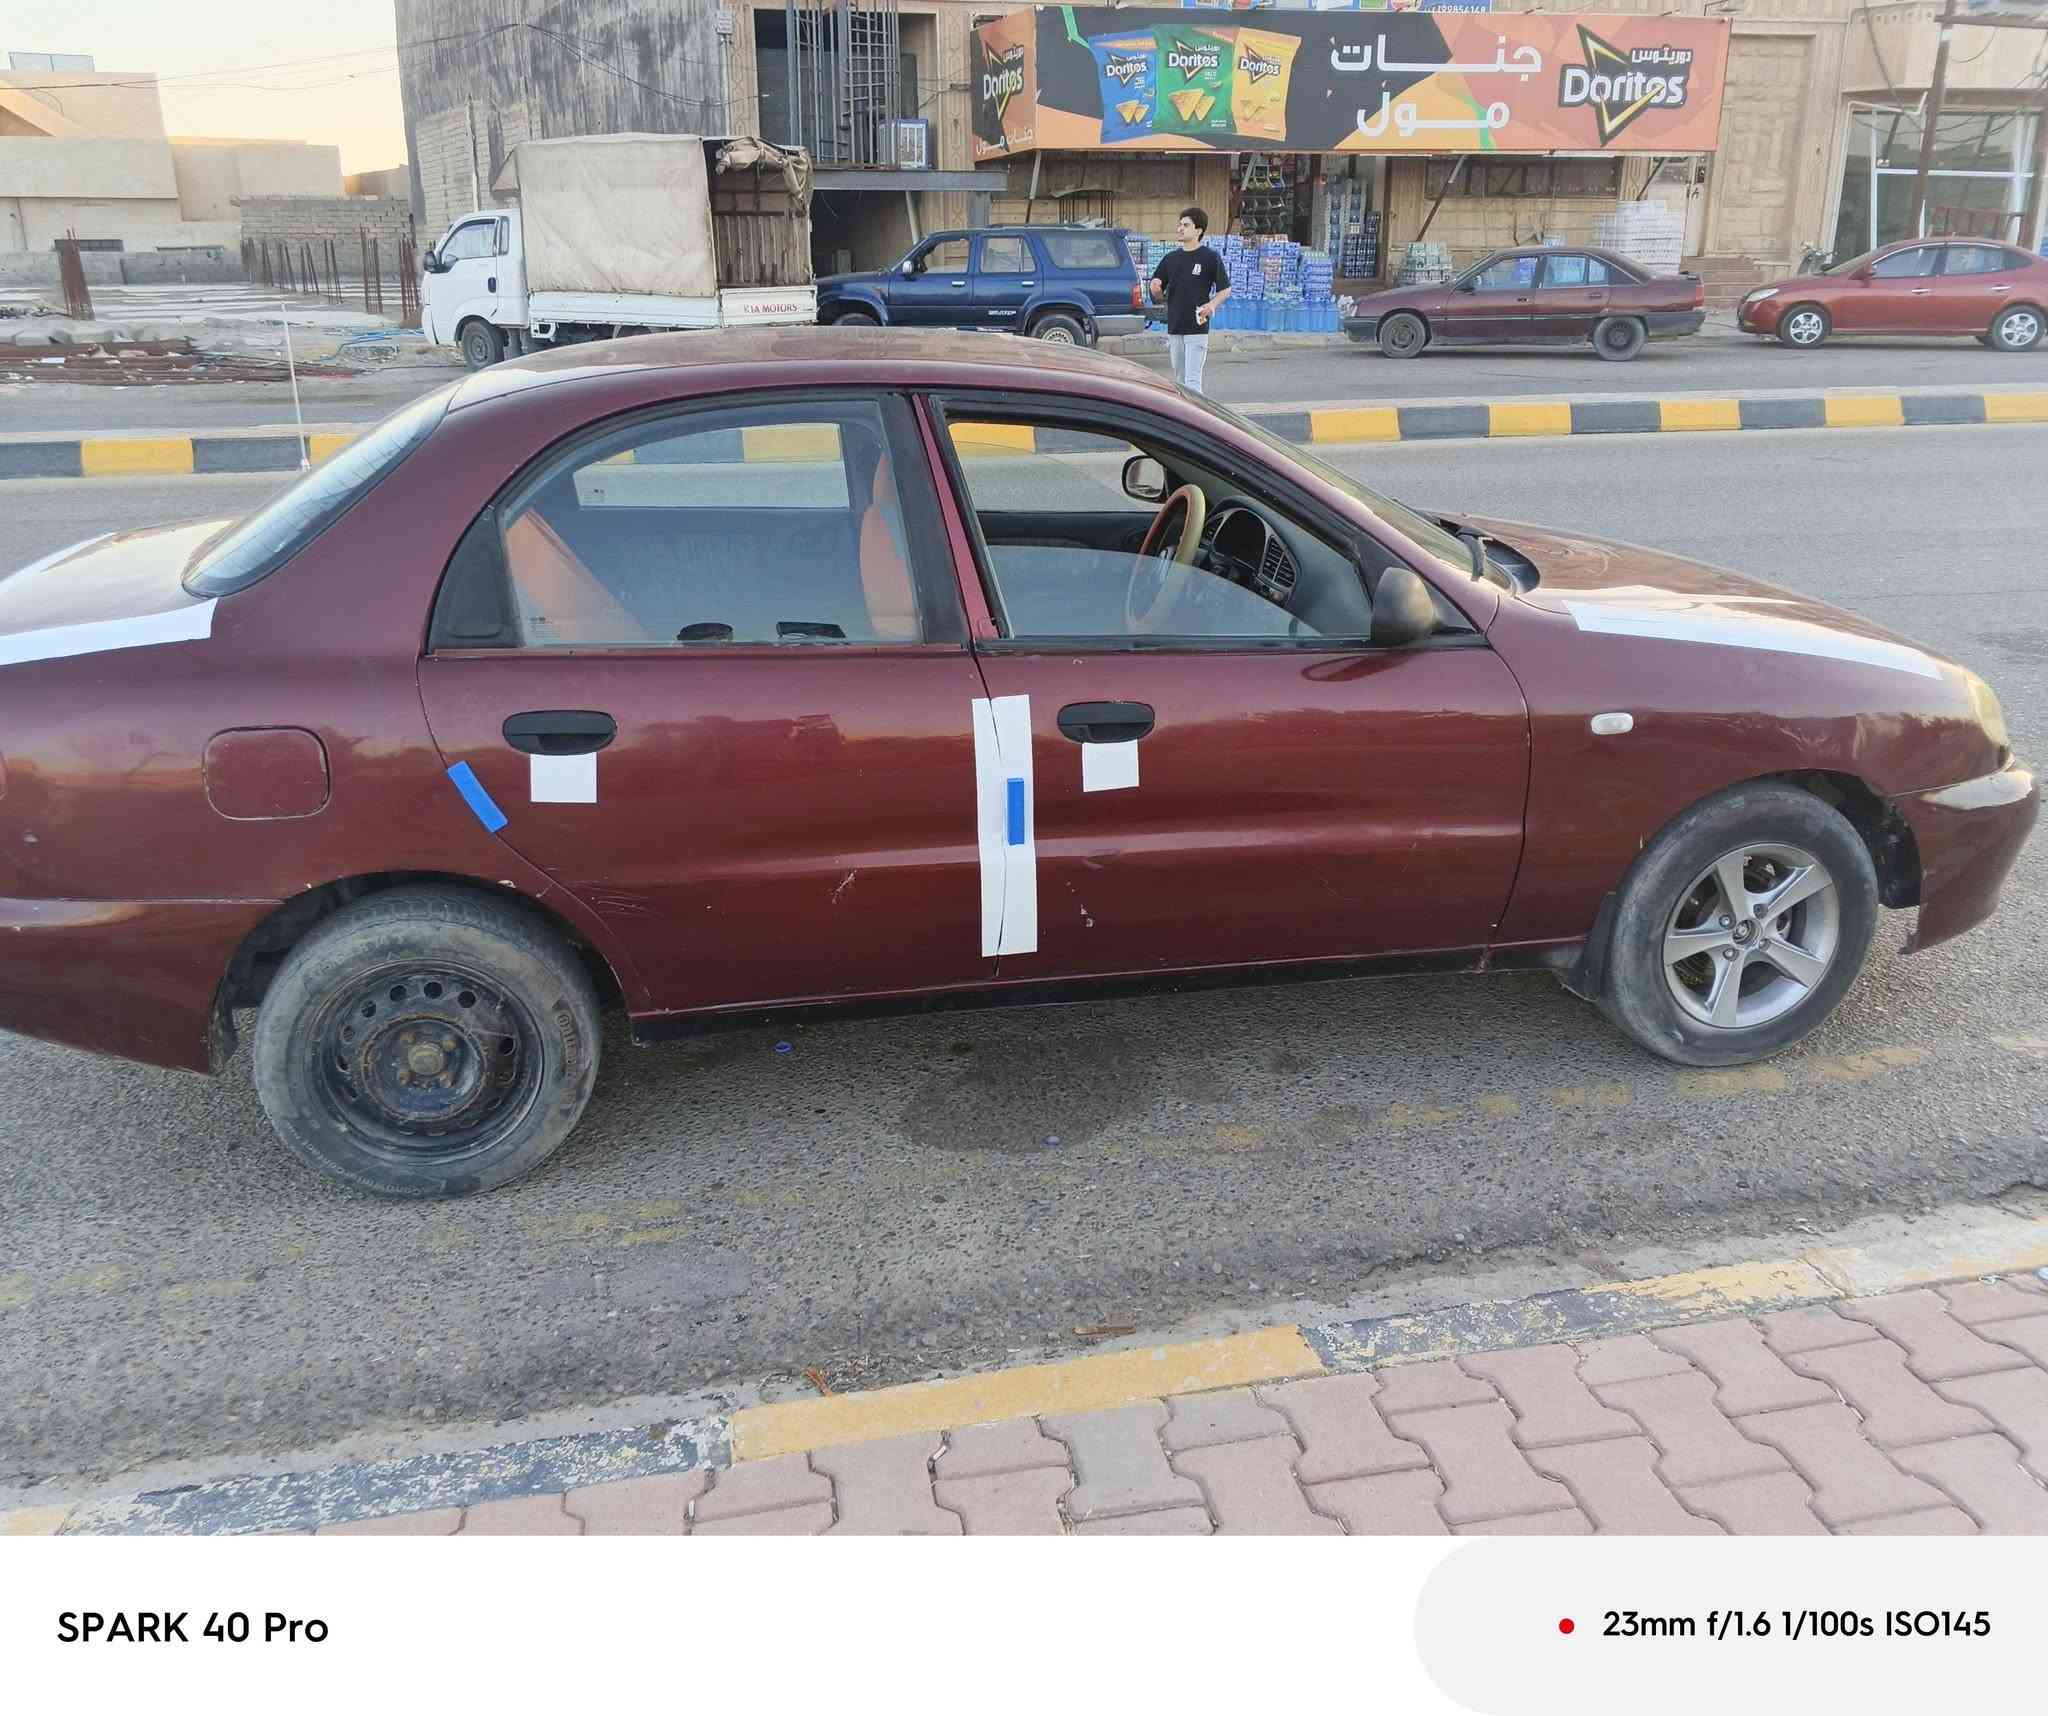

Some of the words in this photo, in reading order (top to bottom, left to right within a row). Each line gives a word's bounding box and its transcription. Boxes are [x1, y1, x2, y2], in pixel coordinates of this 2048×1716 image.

[1168, 53, 1218, 67] Doritos
[1631, 47, 1692, 64] دوريتوس
[1106, 62, 1147, 77] Doritos
[1240, 57, 1280, 75] Doritos
[983, 67, 1023, 100] Doritos
[1564, 67, 1685, 104] Doritos
[1357, 91, 1510, 136] مول
[762, 303, 798, 313] MOTORS
